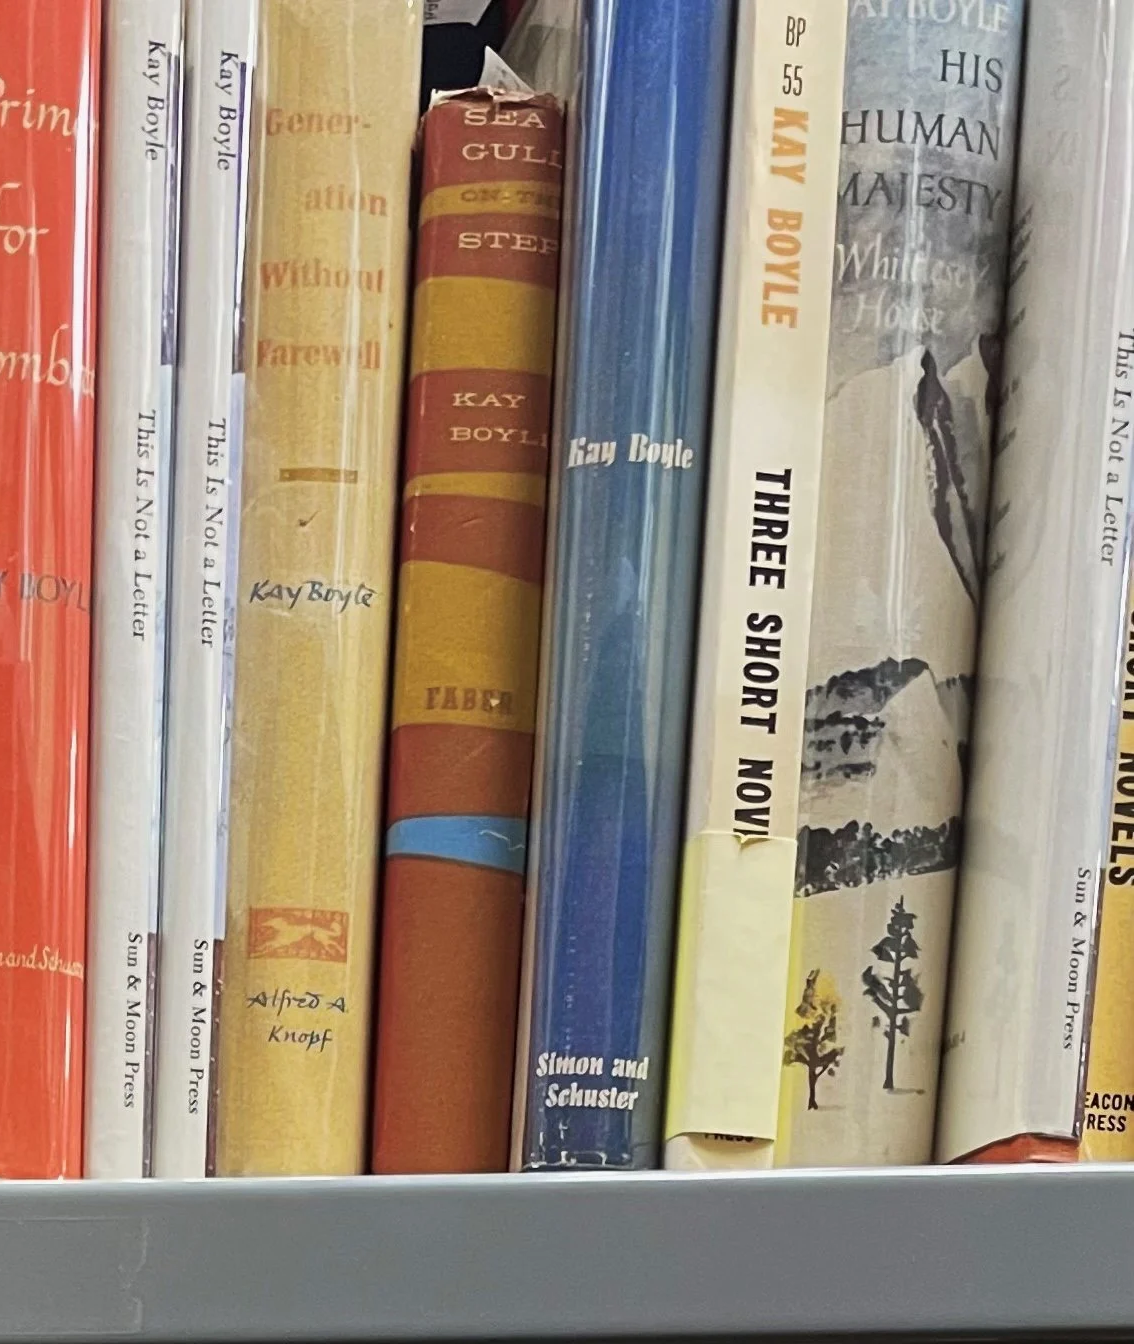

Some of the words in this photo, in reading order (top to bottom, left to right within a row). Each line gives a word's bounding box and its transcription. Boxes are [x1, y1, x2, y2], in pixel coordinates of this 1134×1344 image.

[785, 15, 806, 48] BP
[147, 40, 166, 86] Kay
[219, 50, 240, 96] Kay
[782, 64, 803, 96] 55
[940, 49, 1003, 94] HIS
[143, 97, 164, 163] Boyle
[216, 107, 237, 171] Boyle
[463, 108, 546, 128] SEA
[840, 108, 1000, 161] HUMAN
[770, 106, 809, 184] KAY
[761, 209, 803, 329] BOYLE
[452, 393, 526, 408] KAY
[749, 468, 791, 590] THREE
[742, 612, 783, 734] SHORT
[268, 1025, 332, 1051] Knopf
[536, 1053, 603, 1076] Simon
[612, 1054, 649, 1080] and
[545, 1081, 638, 1111] Schuster
